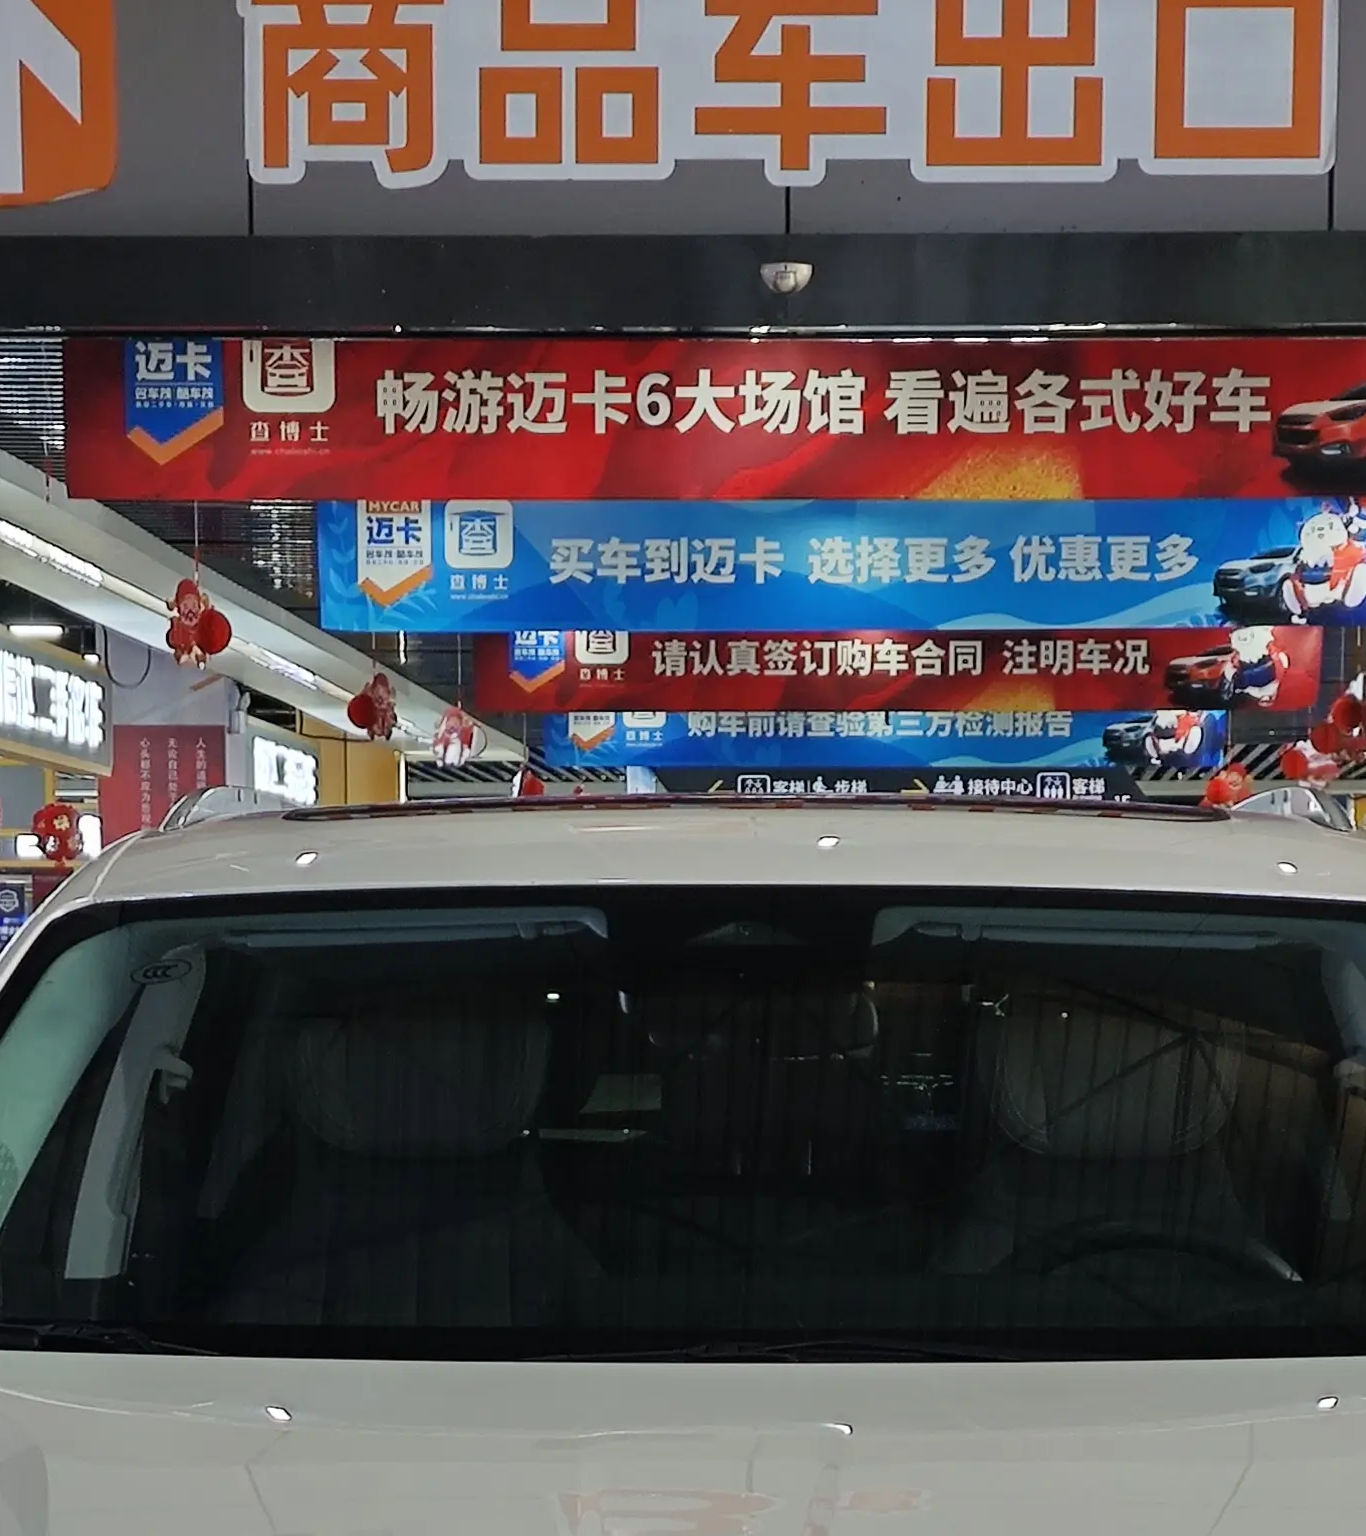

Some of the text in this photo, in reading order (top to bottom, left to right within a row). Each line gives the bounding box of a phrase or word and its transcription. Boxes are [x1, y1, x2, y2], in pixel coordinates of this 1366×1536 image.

[259, 0, 1325, 173] 商品车出口
[136, 342, 212, 381] 迈卡
[376, 368, 1272, 435] 畅游迈卡6大场馆 看遍各式好车
[250, 421, 330, 442] 查博士
[368, 501, 420, 512] MYCAR
[367, 516, 422, 545] 迈卡
[549, 534, 1200, 584] 买车到迈卡 选择更多 优惠更多
[652, 639, 1151, 677] 请认真签订购车合同 注明车况
[688, 711, 1073, 738] 购车前请查验第三方检测报告
[968, 778, 1033, 796] 接待中心
[1072, 778, 1105, 795] 客梯
